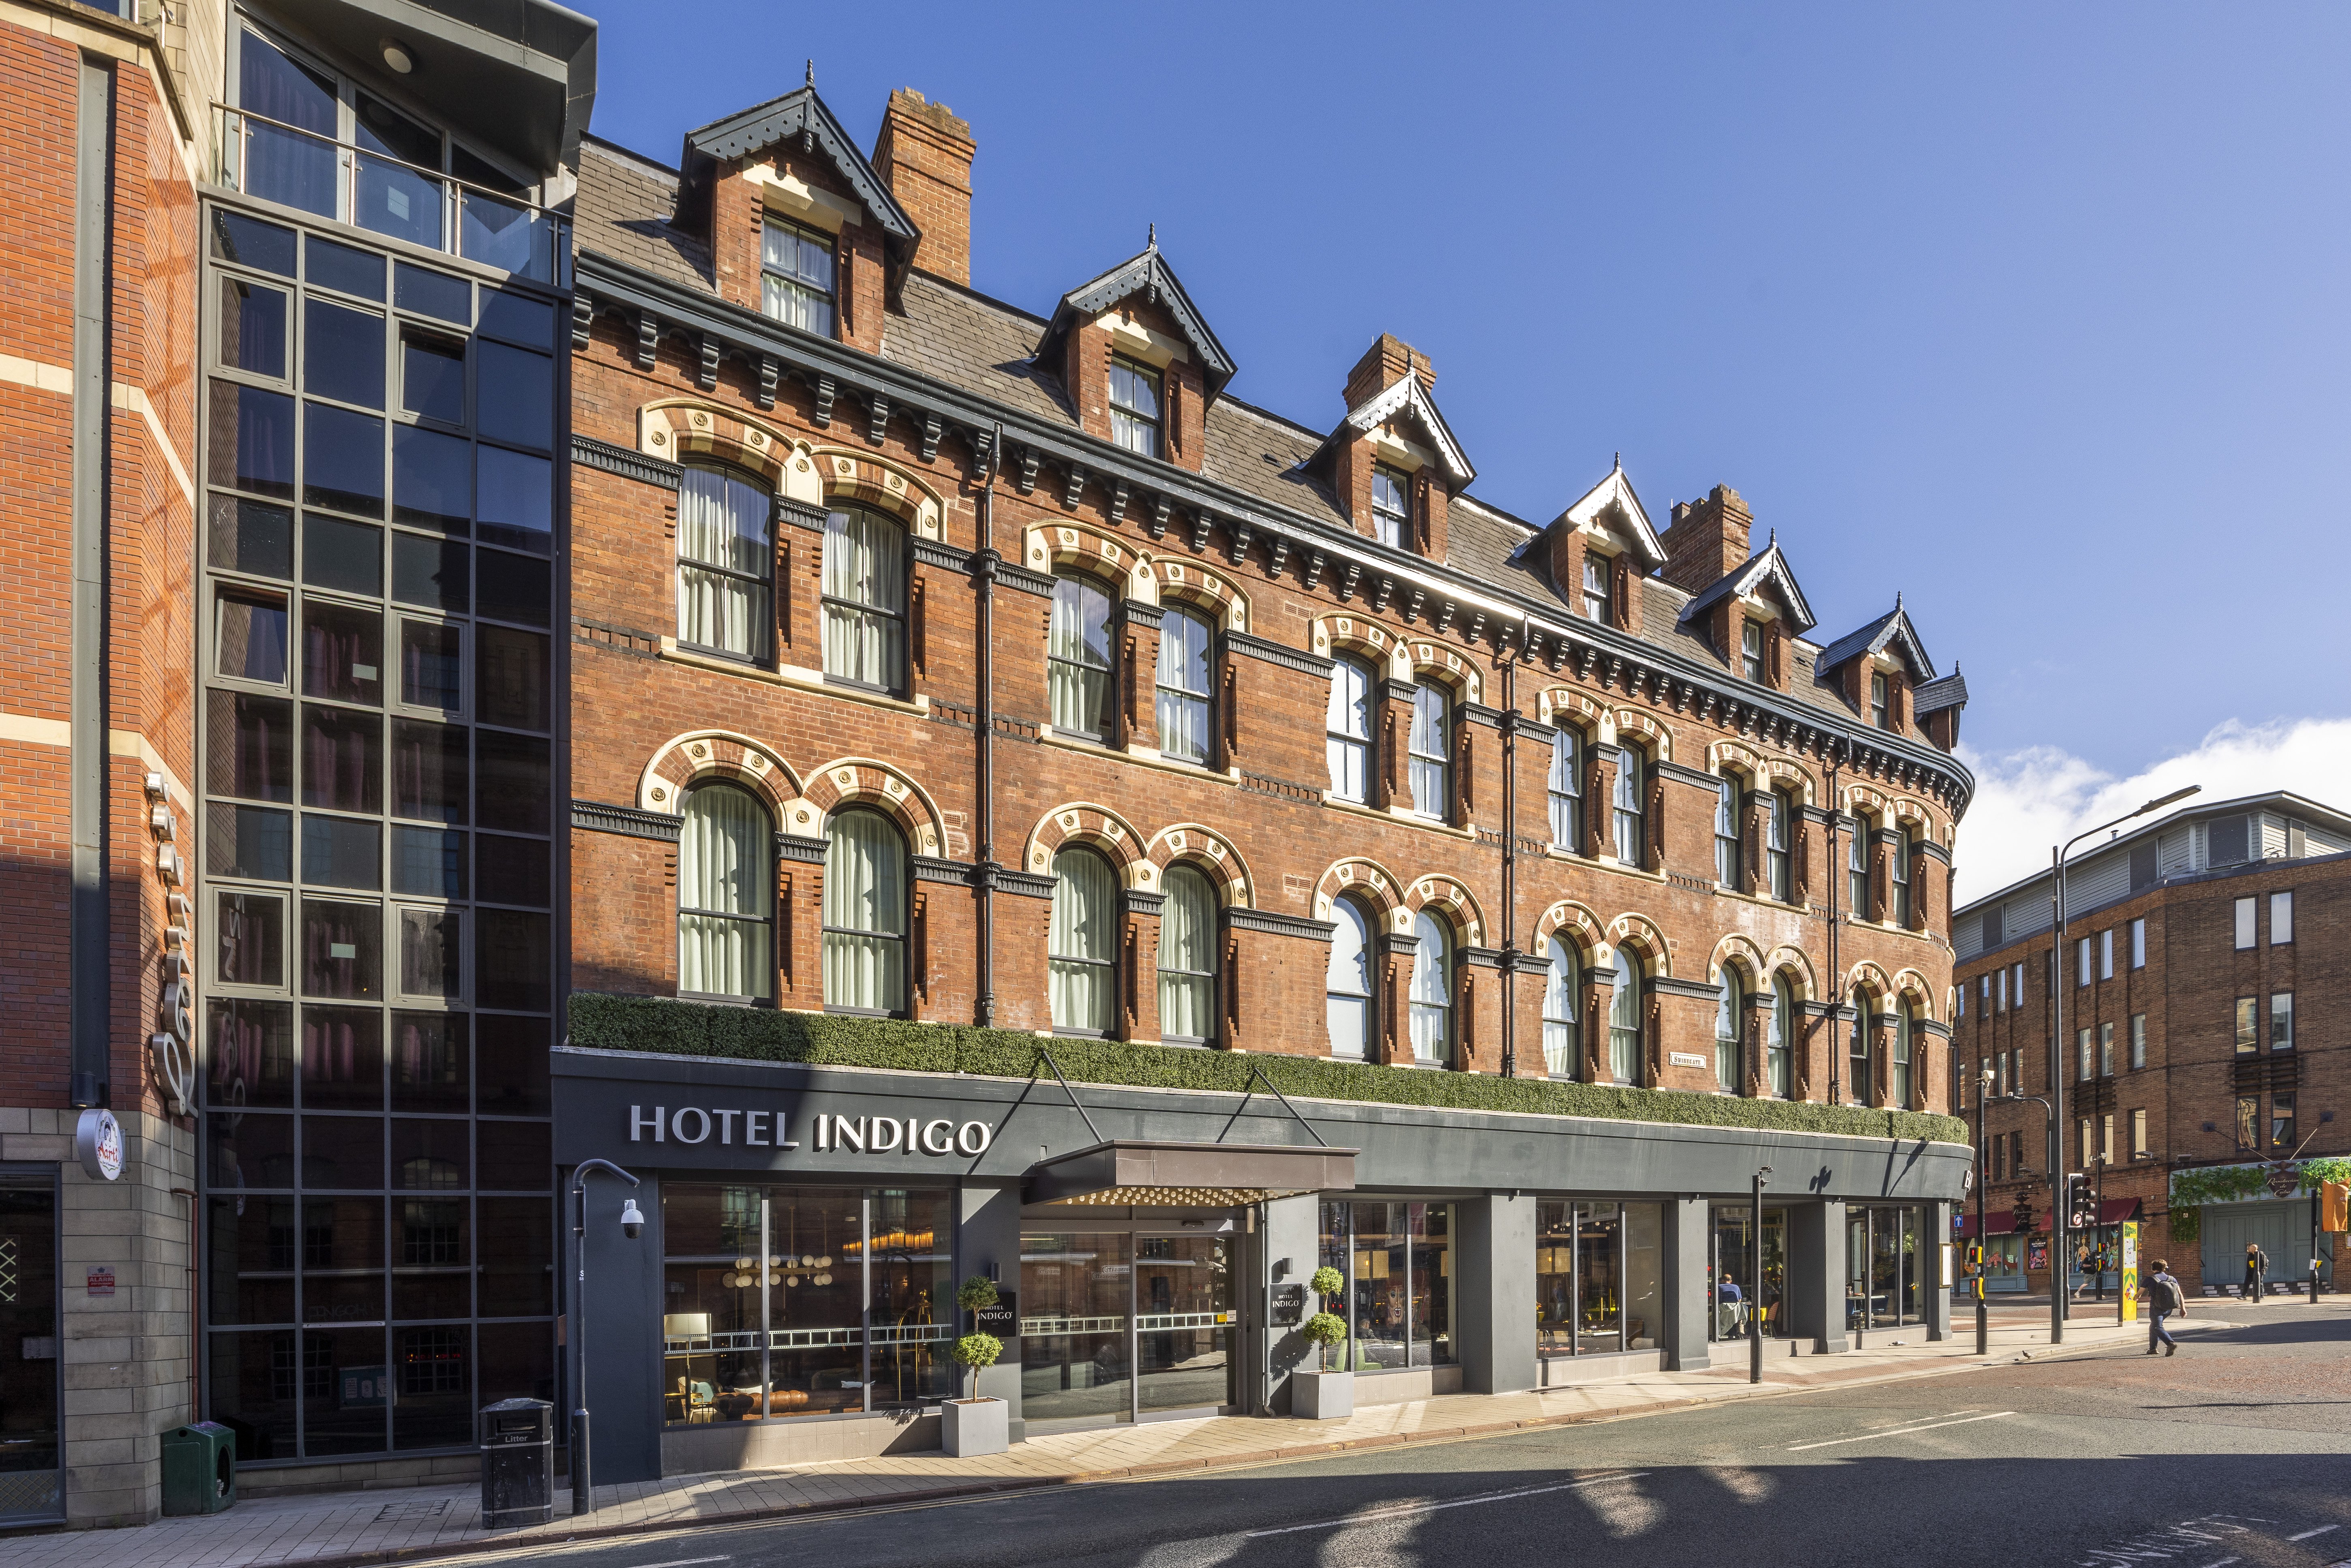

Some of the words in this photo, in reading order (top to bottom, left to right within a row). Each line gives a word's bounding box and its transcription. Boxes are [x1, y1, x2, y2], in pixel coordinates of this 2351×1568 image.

[1674, 1056, 1701, 1065] SWINEGATE
[630, 1105, 799, 1147] HOTEL
[817, 1114, 990, 1154] INDIGO
[2274, 1189, 2291, 1197] Cuba
[977, 1312, 1012, 1320] INDIGO
